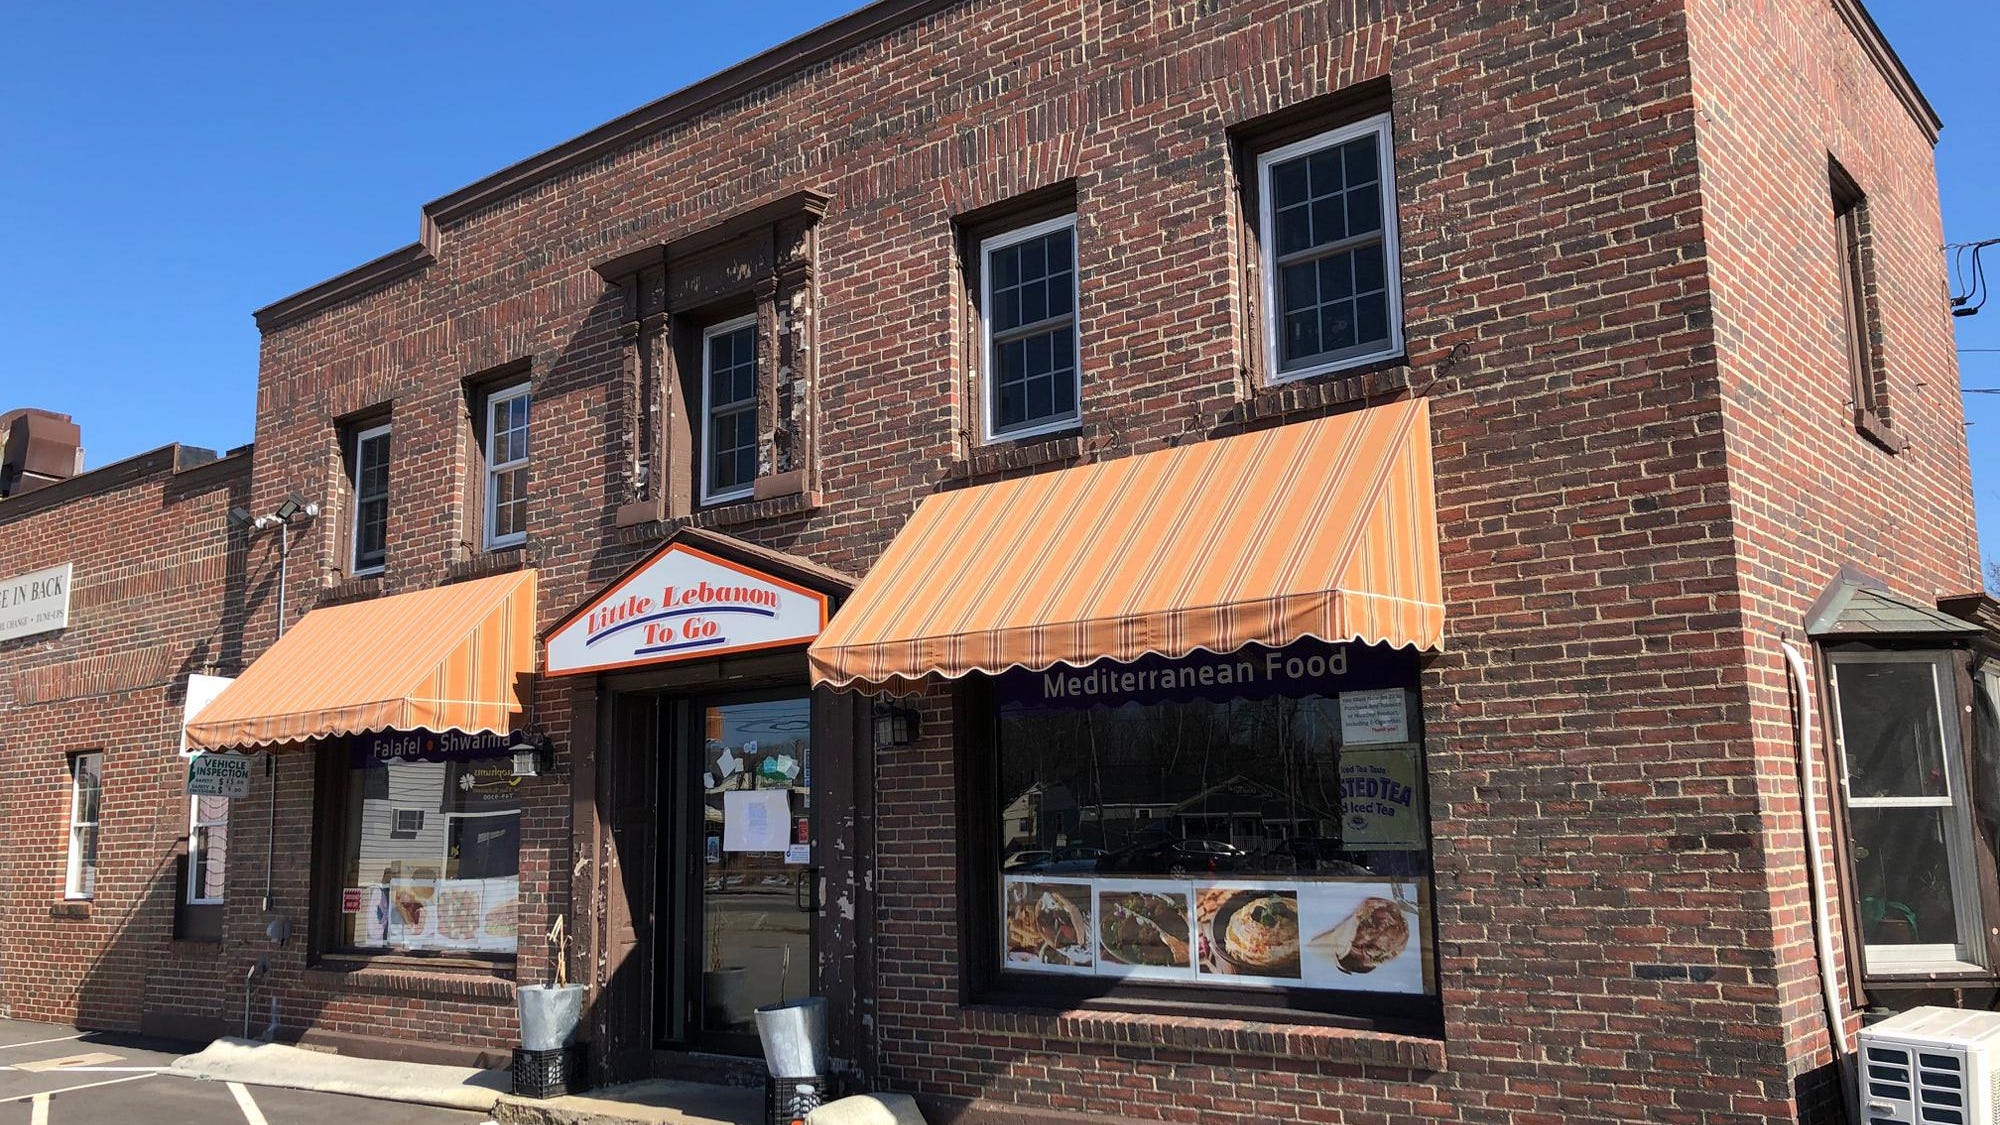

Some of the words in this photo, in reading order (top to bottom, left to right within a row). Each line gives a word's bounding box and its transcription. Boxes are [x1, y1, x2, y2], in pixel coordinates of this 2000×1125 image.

[0, 589, 9, 609] E
[13, 585, 27, 606] IN
[31, 575, 63, 601] BACK
[586, 594, 652, 636] Little
[662, 581, 778, 609] Lebanon
[643, 622, 674, 645] To
[682, 617, 718, 640] Go
[1043, 659, 1254, 699] Mediterranean
[1266, 646, 1348, 681] Food
[373, 735, 421, 758] Falafel
[440, 733, 511, 752] Shwarma
[196, 766, 249, 779] INSPECTION
[204, 758, 247, 770] VEHICLE
[1379, 776, 1412, 808] TEA
[1350, 802, 1374, 814] Iced
[1375, 802, 1396, 817] Tea
